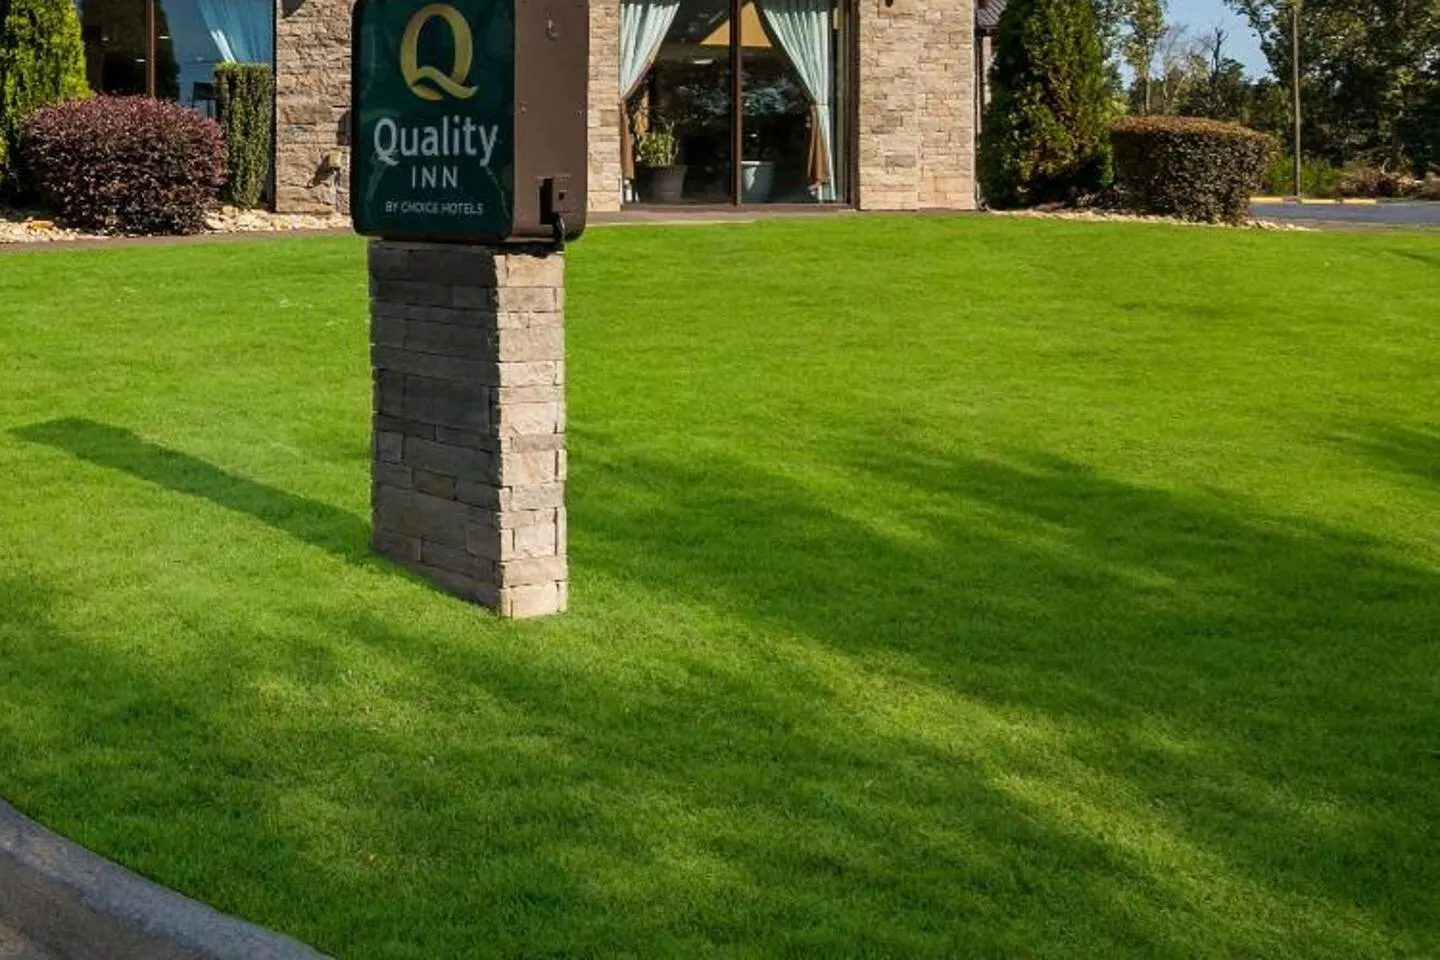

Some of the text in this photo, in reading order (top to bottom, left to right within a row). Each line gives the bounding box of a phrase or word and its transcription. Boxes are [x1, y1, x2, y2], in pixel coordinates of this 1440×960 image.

[400, 3, 478, 101] Q
[373, 115, 499, 167] Quality
[411, 165, 458, 189] INN
[385, 200, 484, 216] BY CHOICE HOTELS
